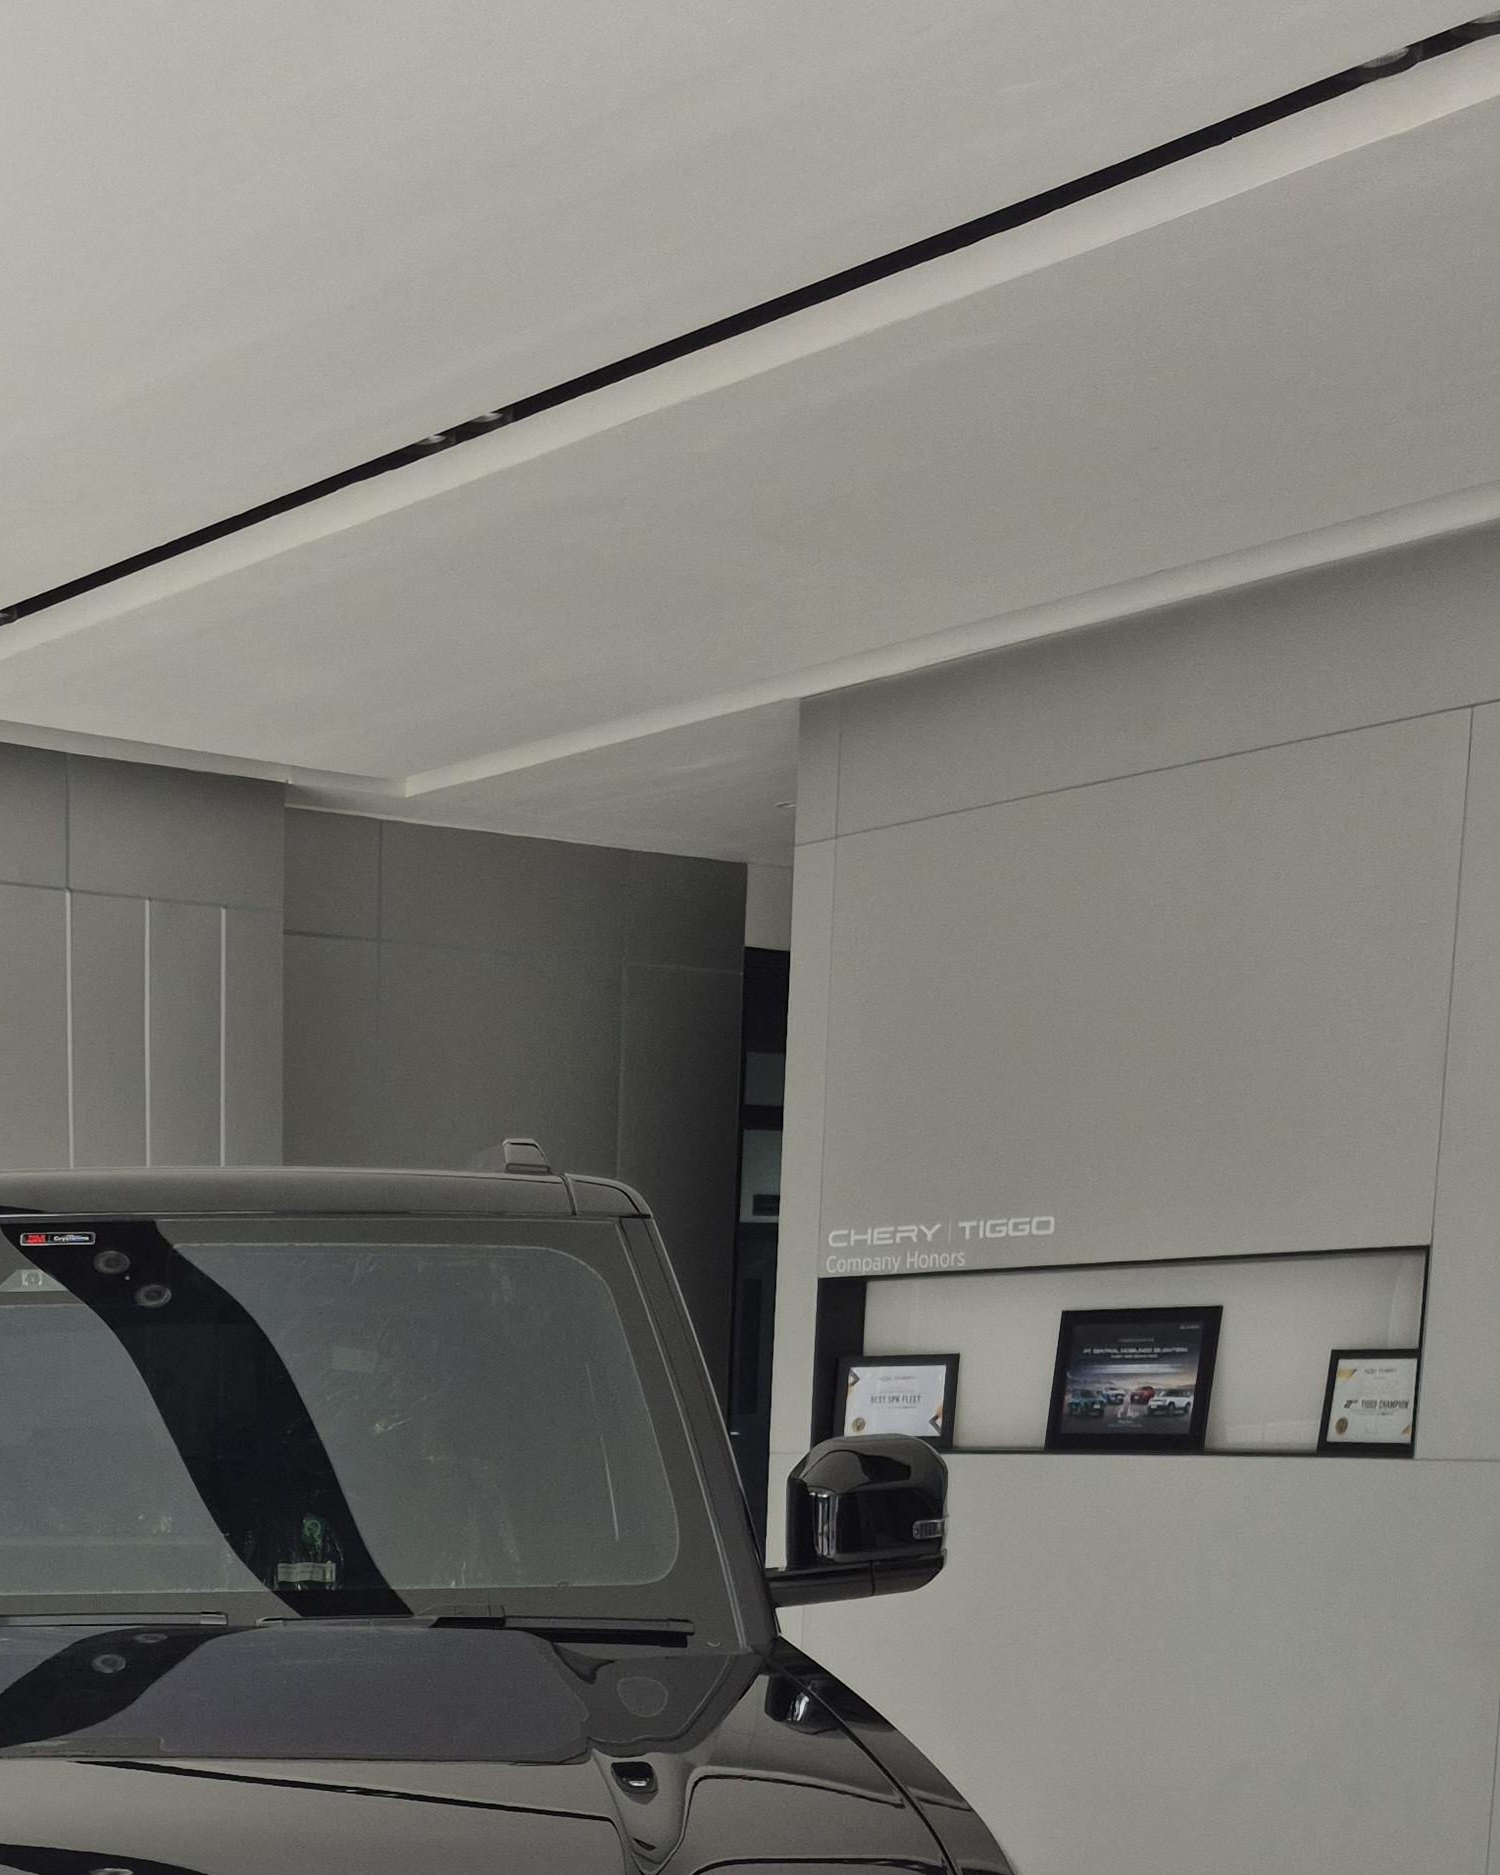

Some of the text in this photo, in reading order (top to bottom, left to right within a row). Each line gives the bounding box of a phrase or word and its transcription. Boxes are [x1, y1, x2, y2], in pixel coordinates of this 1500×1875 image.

[828, 1216, 1055, 1247] CHERY TIGGO
[826, 1250, 966, 1274] Company Honors
